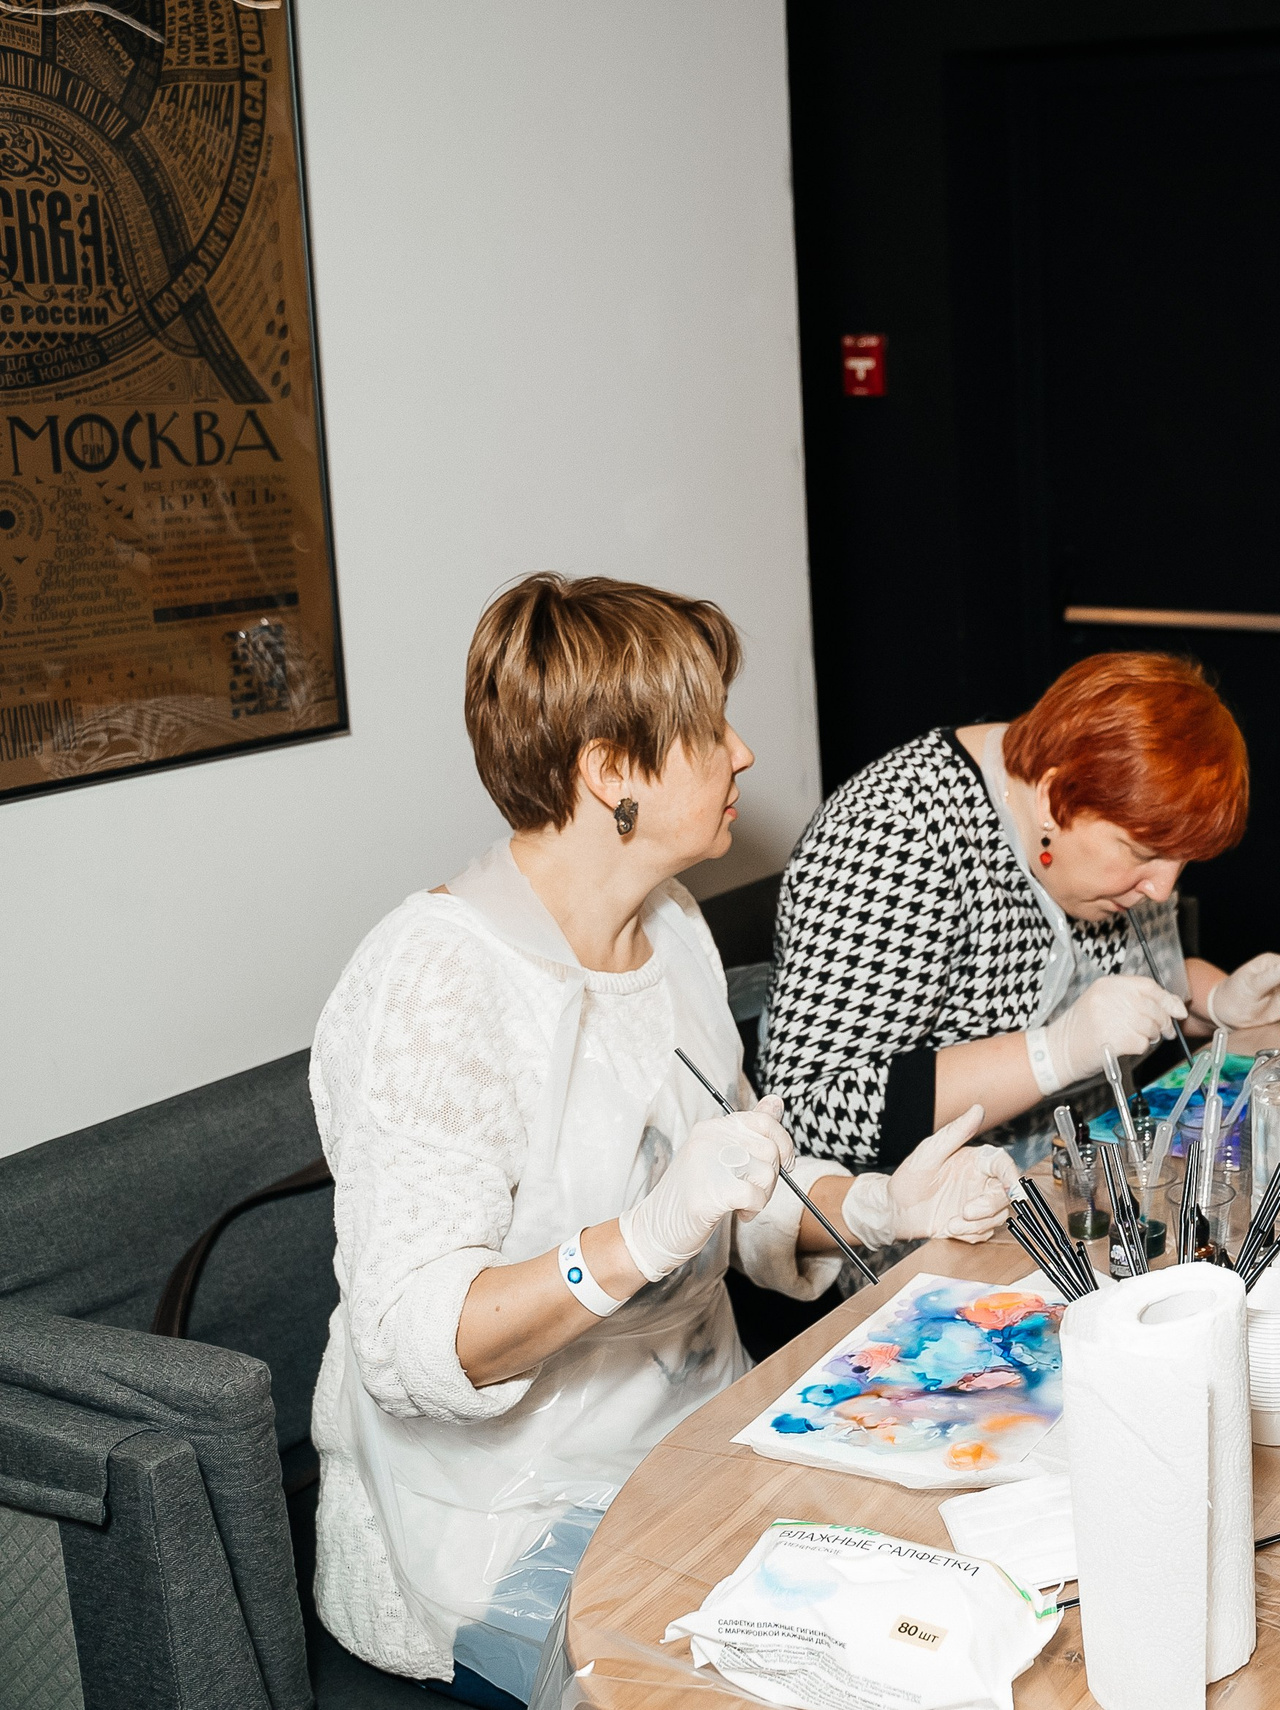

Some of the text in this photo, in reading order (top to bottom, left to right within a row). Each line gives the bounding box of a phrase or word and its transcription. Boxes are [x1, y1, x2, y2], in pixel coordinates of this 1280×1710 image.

[175, 13, 192, 66] КОГДА
[20, 305, 110, 325] РОССИИ
[32, 339, 95, 367] СОЛНЦЕ
[39, 353, 101, 382] КОЛЬЦО
[7, 408, 284, 477] МОСКВА
[779, 1529, 980, 1577] ВЛАЖНЫЕ САЛФЕТКИ
[717, 1619, 755, 1628] САЛФЕТКИ
[756, 1621, 795, 1632] ВЛАЖНЫЕ
[724, 1627, 780, 1637] МАРКИРОВКОЙ
[781, 1631, 814, 1643] КАЖДЫЙ
[897, 1622, 919, 1637] 80
